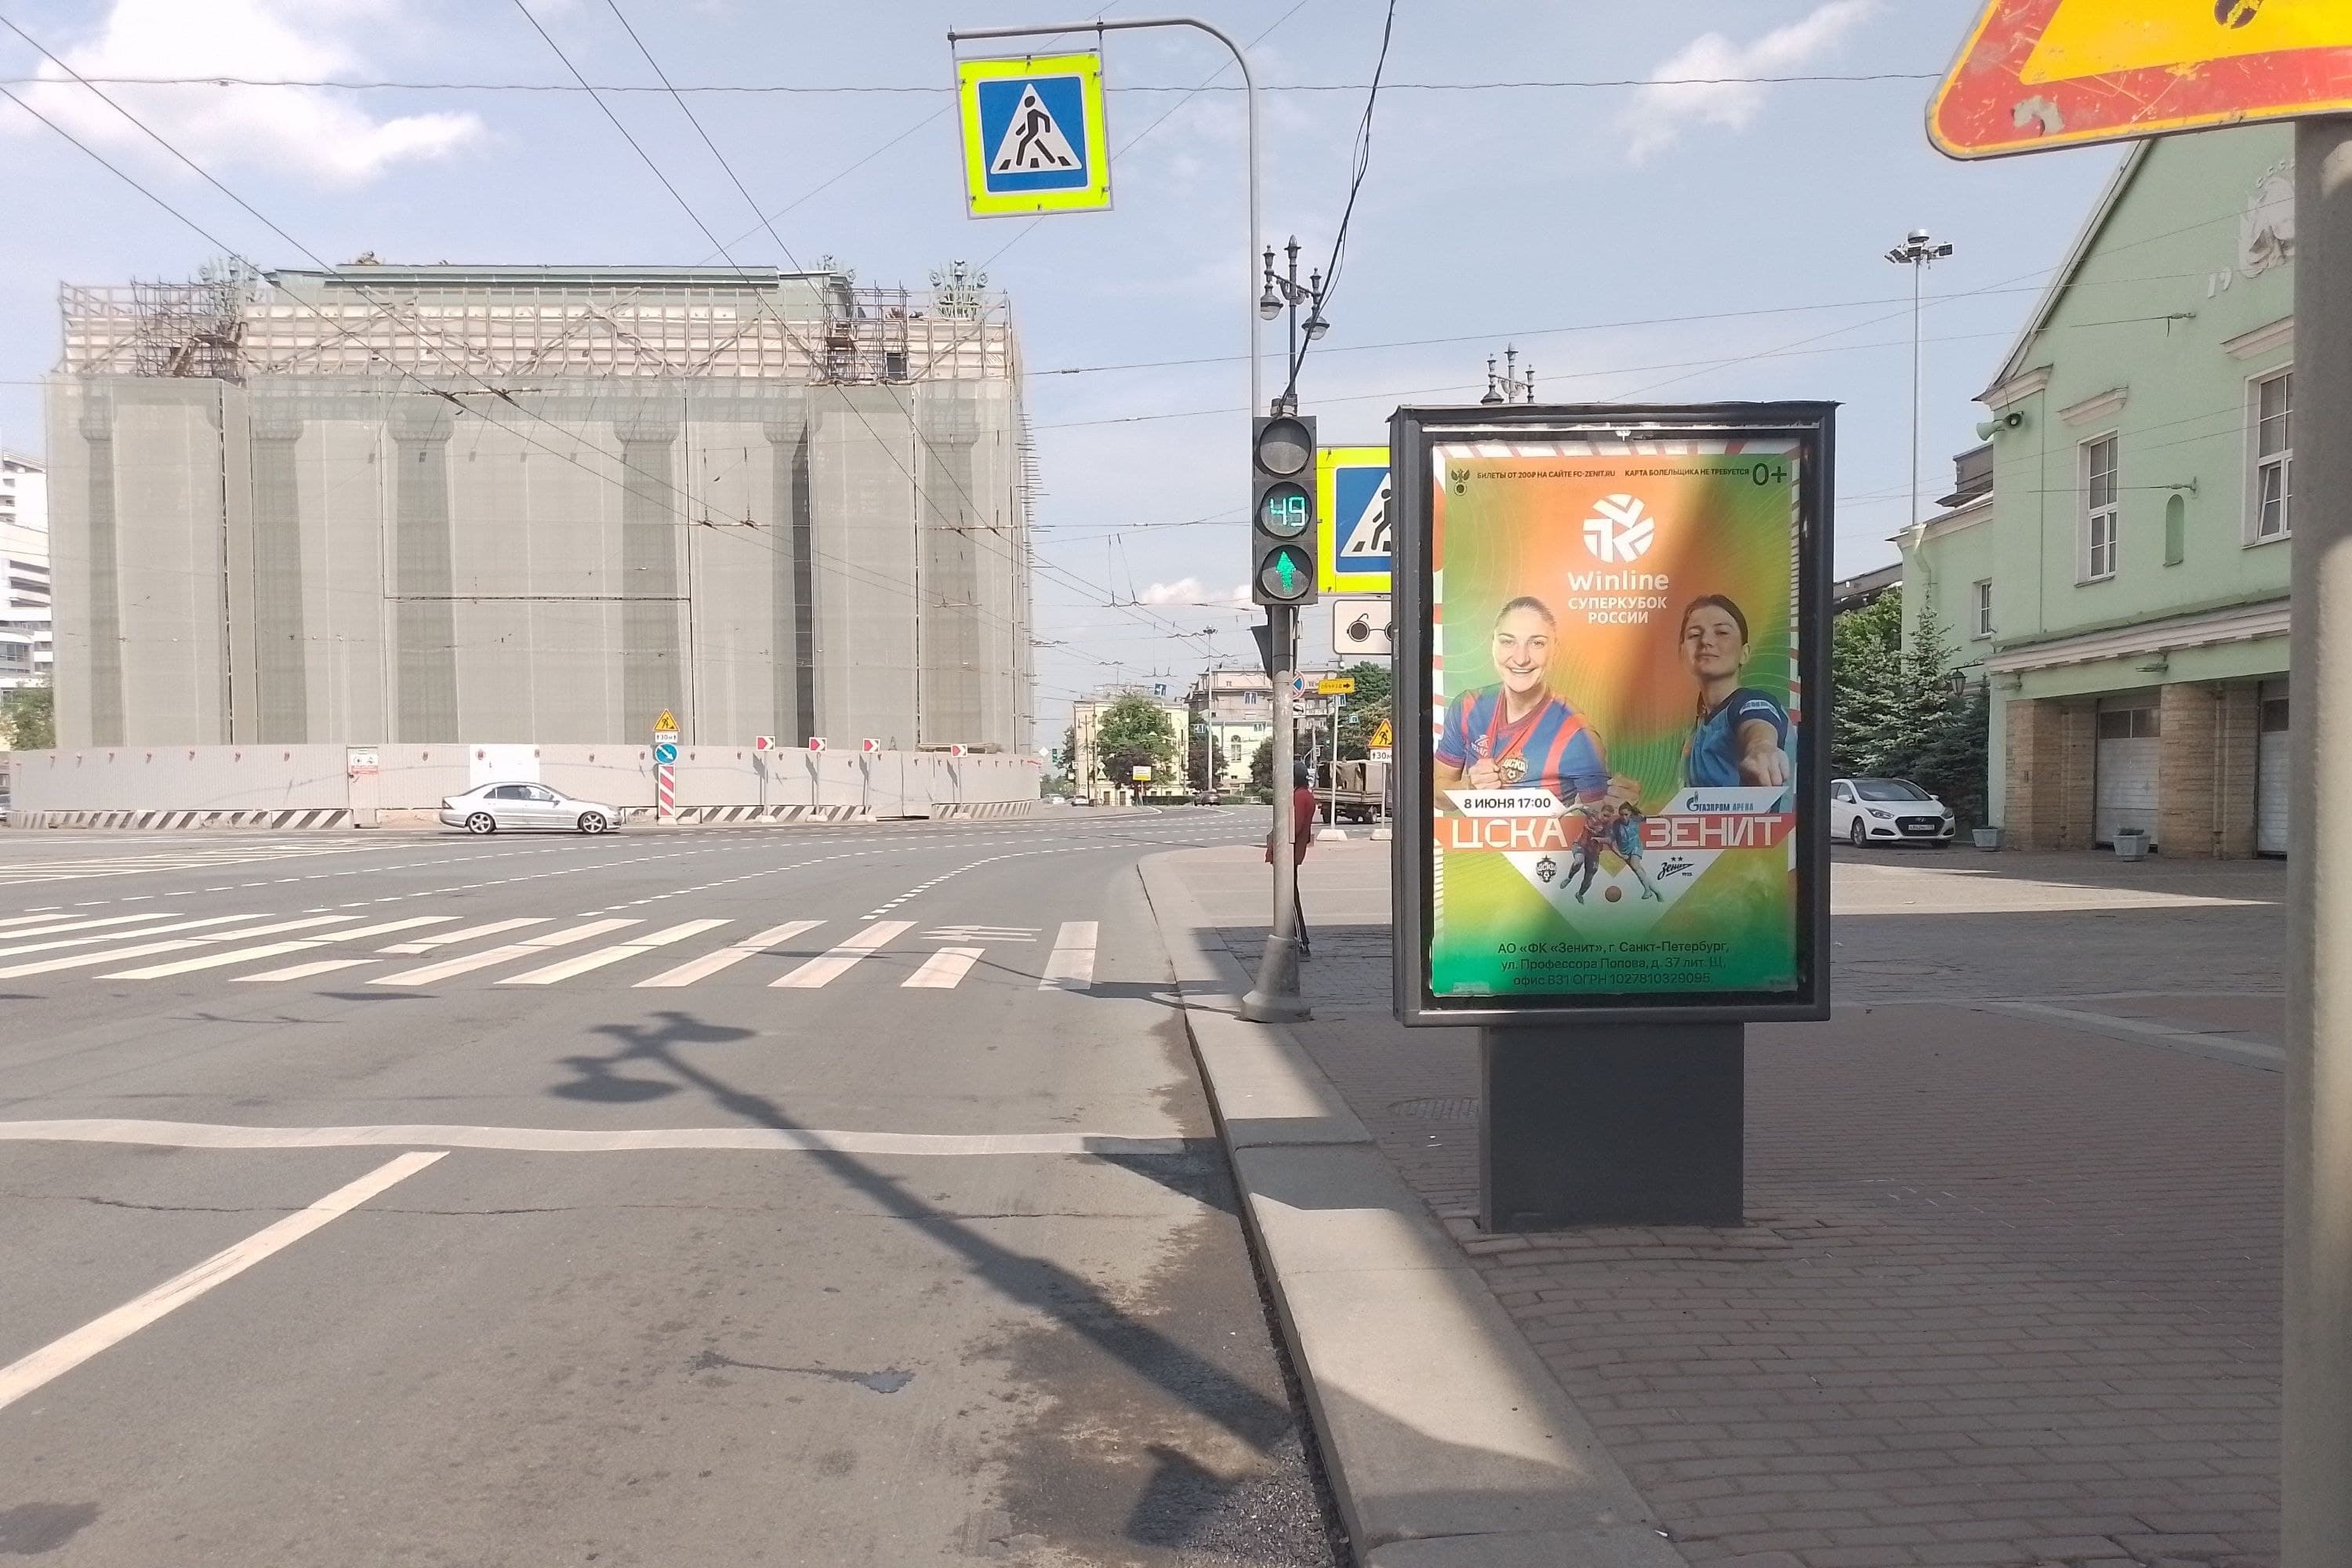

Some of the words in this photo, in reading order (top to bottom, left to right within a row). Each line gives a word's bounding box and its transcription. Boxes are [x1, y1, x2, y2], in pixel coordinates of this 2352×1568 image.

[1752, 463, 1788, 486] 0+
[1270, 496, 1305, 526] 49
[1567, 569, 1669, 591] Winline
[1568, 597, 1668, 610] СУПЕРКУБОК
[1588, 611, 1649, 624] РОССИИ
[1464, 798, 1472, 809] 8
[1475, 798, 1515, 809] ИЮНЯ
[1517, 797, 1551, 808] 17:00
[1700, 803, 1730, 811] ГАЗПРОМ
[1452, 818, 1569, 848] ЦСКА
[1646, 816, 1782, 848] ЗЕНИТ
[1497, 942, 1516, 953] АО
[1519, 942, 1547, 953] «ФК
[1551, 942, 1606, 953] «Зенит»,
[1619, 941, 1730, 953] Санкт-Петербург,
[1521, 959, 1597, 971] Профессора
[1601, 958, 1649, 970] Попова,
[1665, 957, 1680, 968] 37
[1514, 975, 1545, 987] офис
[1548, 975, 1570, 985] 831
[1573, 974, 1607, 985] ОГРН
